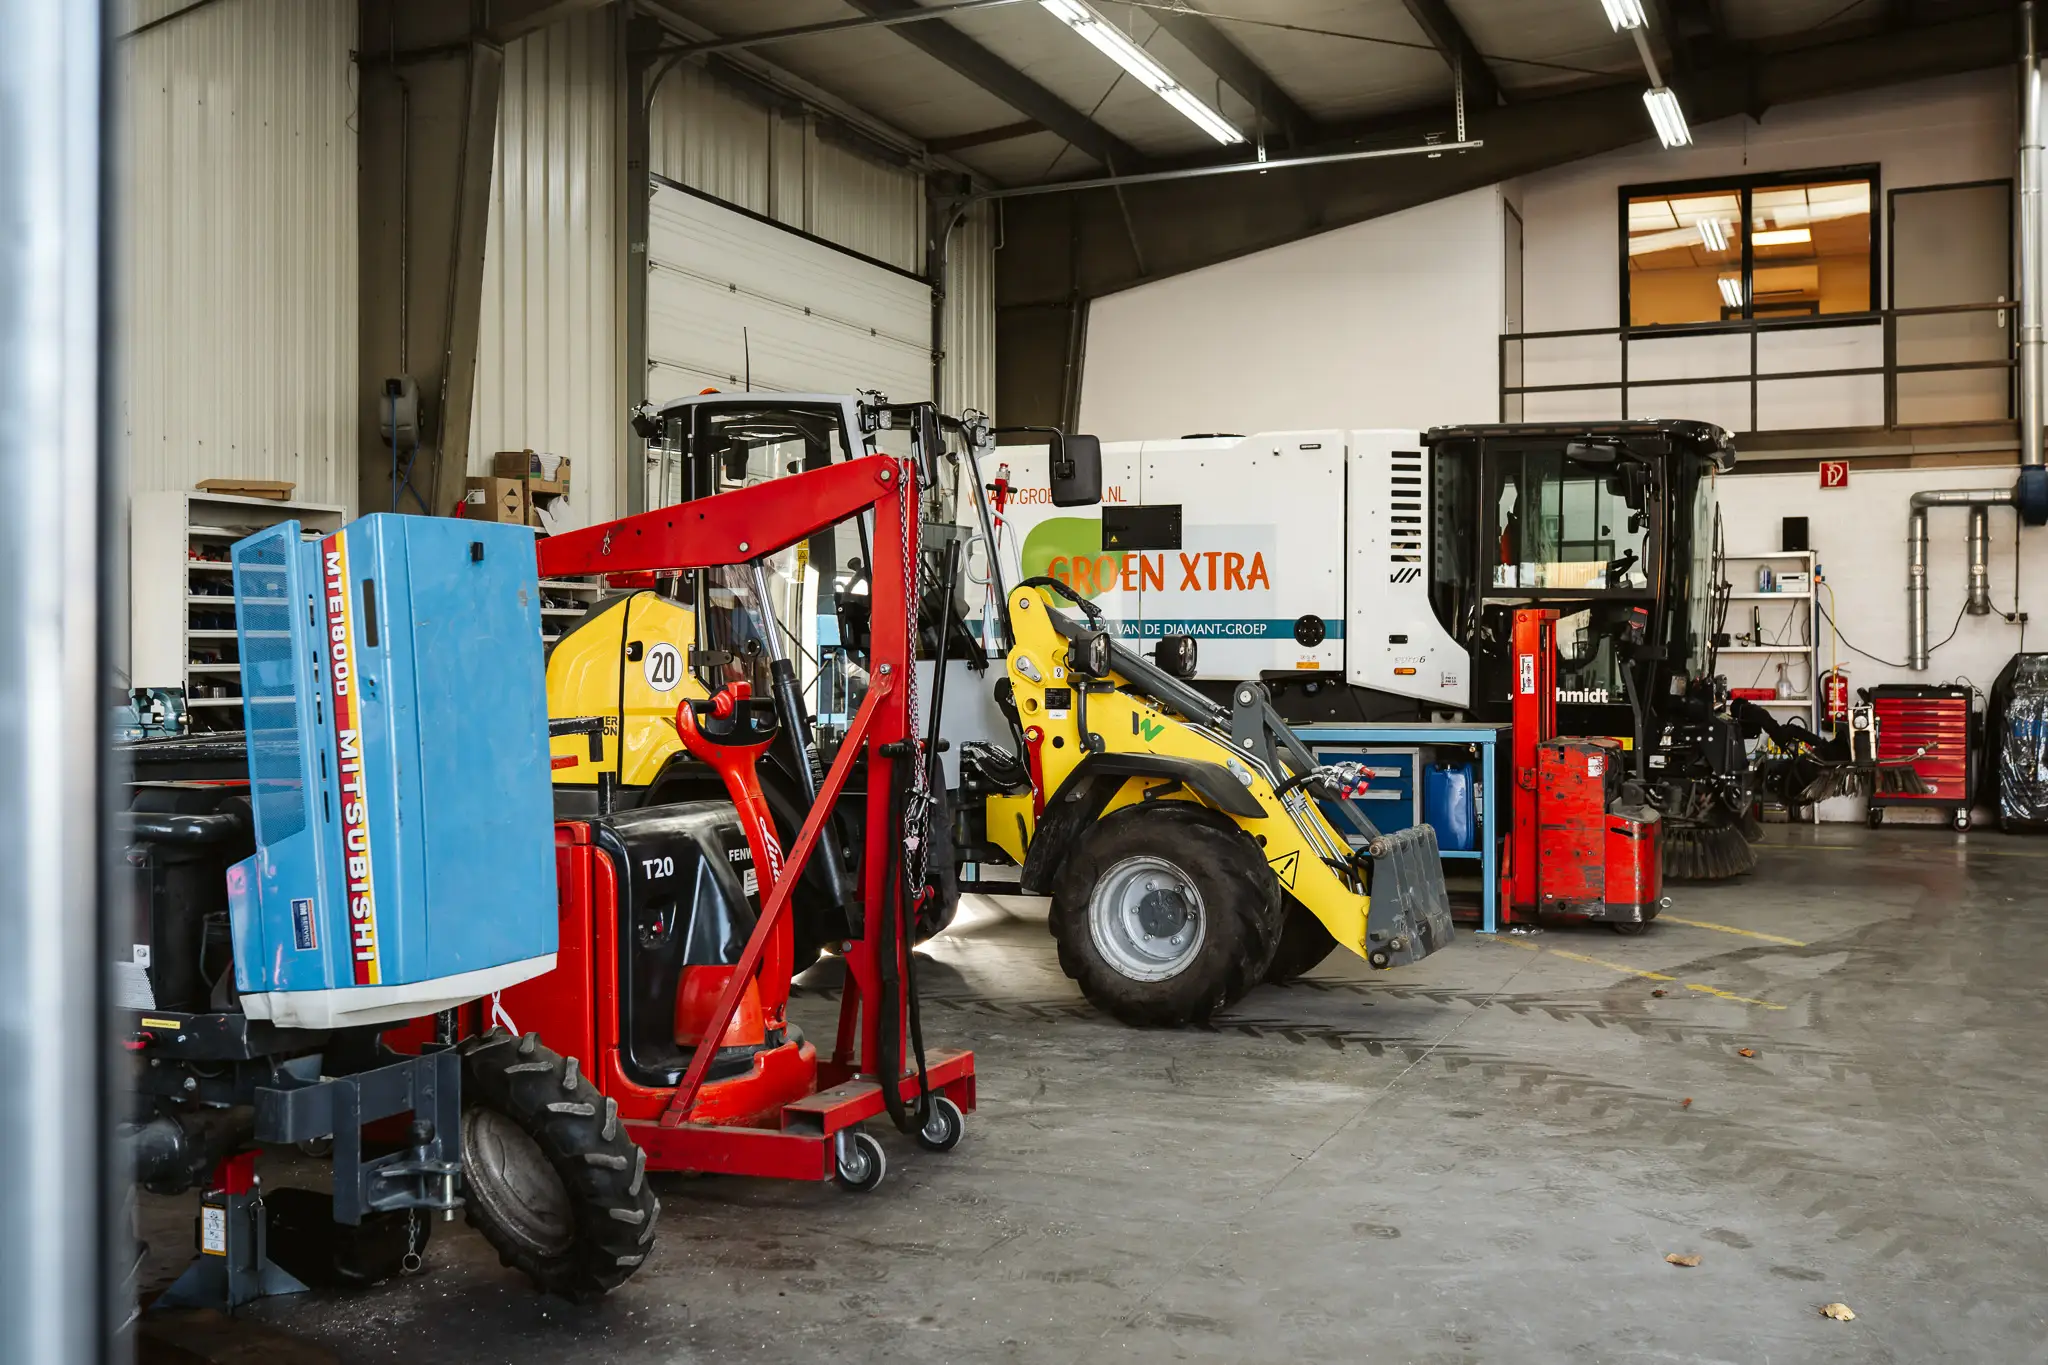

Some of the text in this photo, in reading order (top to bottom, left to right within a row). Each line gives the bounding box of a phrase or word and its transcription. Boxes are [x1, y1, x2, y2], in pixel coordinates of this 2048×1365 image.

[1047, 551, 1270, 594] GROEN XTRA
[326, 551, 349, 696] MTE1800D
[1116, 623, 1139, 635] VAN
[1144, 623, 1161, 635] DE
[1164, 623, 1267, 635] DIAMANT-GROEP
[651, 651, 676, 683] 20
[1556, 687, 1609, 704] hmidt
[339, 729, 375, 962] MITSUBISHI
[728, 847, 753, 862] FENW
[760, 816, 785, 883] Lin
[642, 856, 674, 880] T20
